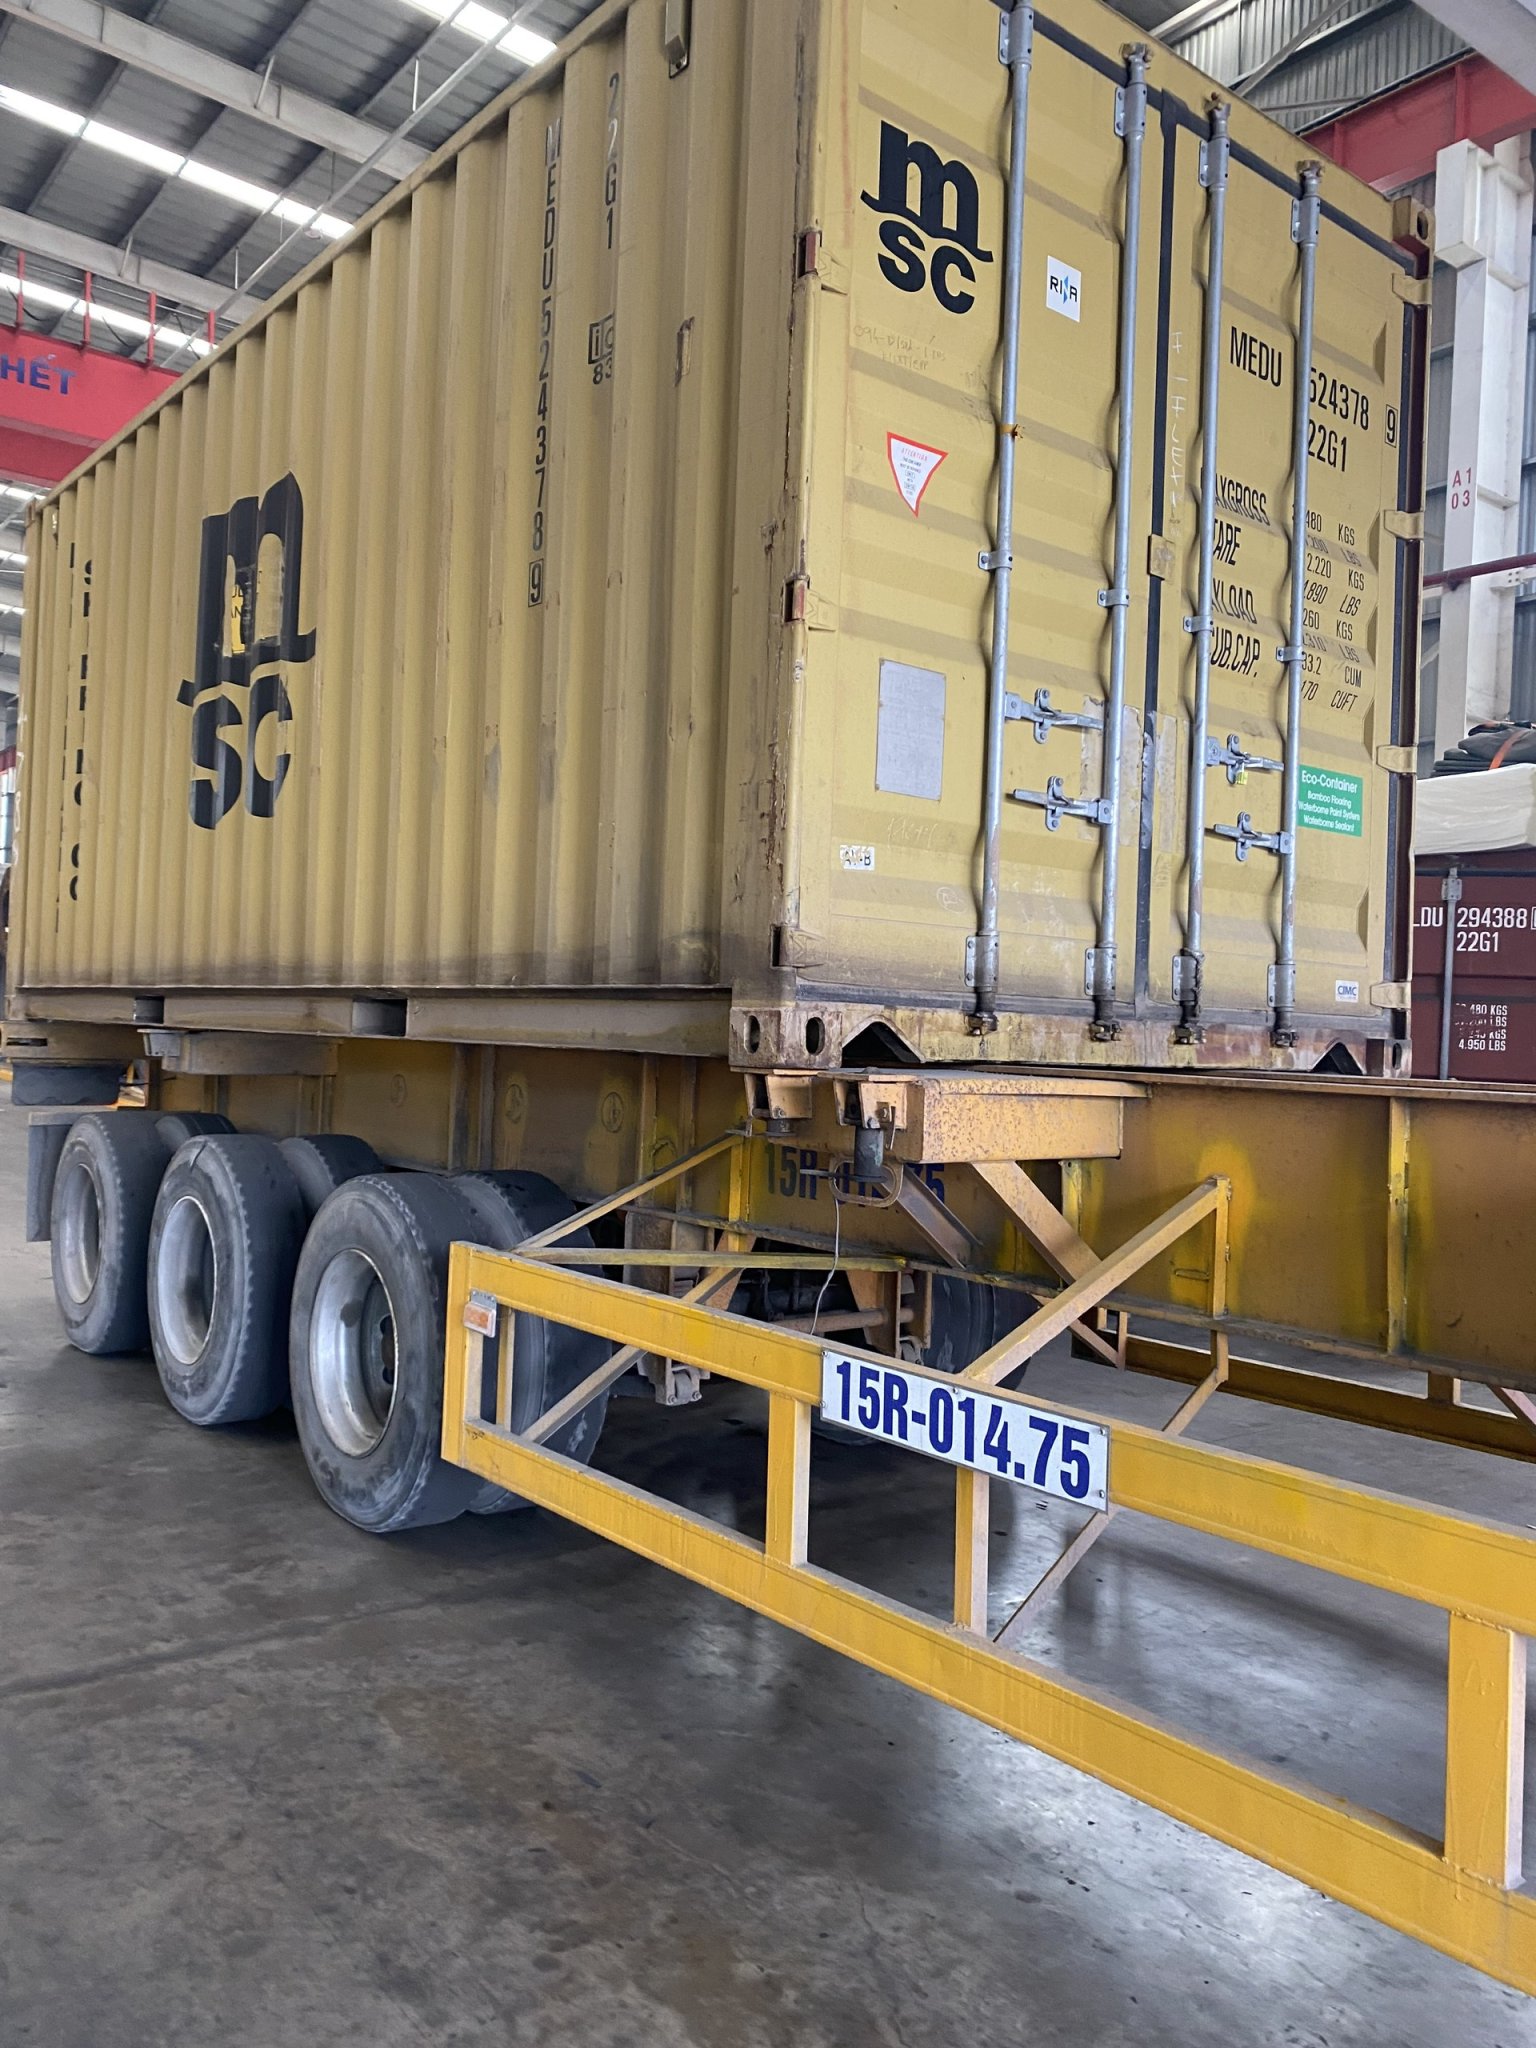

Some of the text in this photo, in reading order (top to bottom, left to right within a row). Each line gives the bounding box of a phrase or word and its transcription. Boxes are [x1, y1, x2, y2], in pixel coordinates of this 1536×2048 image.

[1229, 325, 1397, 444] MEDU 524378 9
[1307, 419, 1348, 473] 22G1
[1214, 472, 1355, 546] AXGROSS 480 KGS
[1306, 552, 1331, 579] 2.220
[1348, 568, 1365, 591] KGS
[1211, 577, 1258, 625] YLOAD
[1336, 619, 1353, 642] KGS
[1339, 594, 1361, 617] LBS
[1210, 625, 1261, 678] UB.CAP.
[1344, 665, 1362, 688] CUM
[1330, 689, 1358, 712] CUFT
[1301, 770, 1358, 794] Eco-Container
[1307, 790, 1331, 803] Bamboo
[1303, 814, 1335, 829] Waterborne
[1456, 907, 1528, 929] 294388
[1456, 931, 1499, 953] 22G1
[1490, 1004, 1508, 1016] KGS
[1458, 1038, 1506, 1051] 4.950 LBS
[836, 1360, 1090, 1499] 15R-014.75
